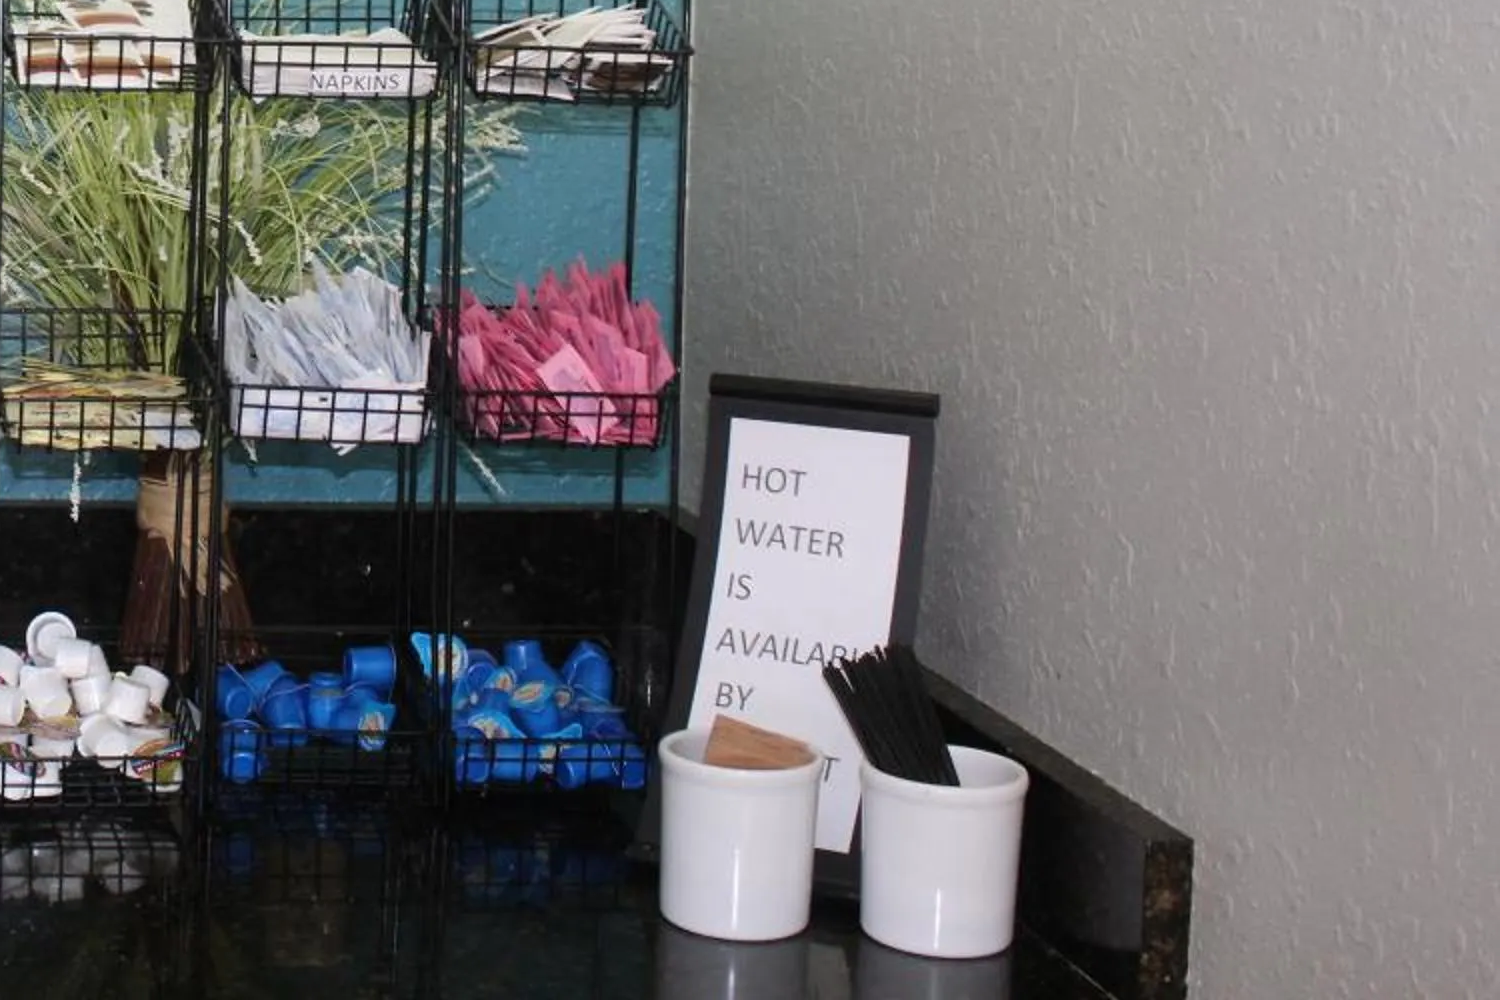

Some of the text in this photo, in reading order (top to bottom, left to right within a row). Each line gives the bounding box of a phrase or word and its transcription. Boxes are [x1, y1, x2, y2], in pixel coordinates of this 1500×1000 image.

[309, 72, 401, 92] NAPKINS
[741, 463, 808, 498] HOT
[735, 516, 846, 559] WATER
[727, 572, 754, 601] IS
[715, 627, 878, 669] AVAILAB
[714, 681, 754, 712] BY
